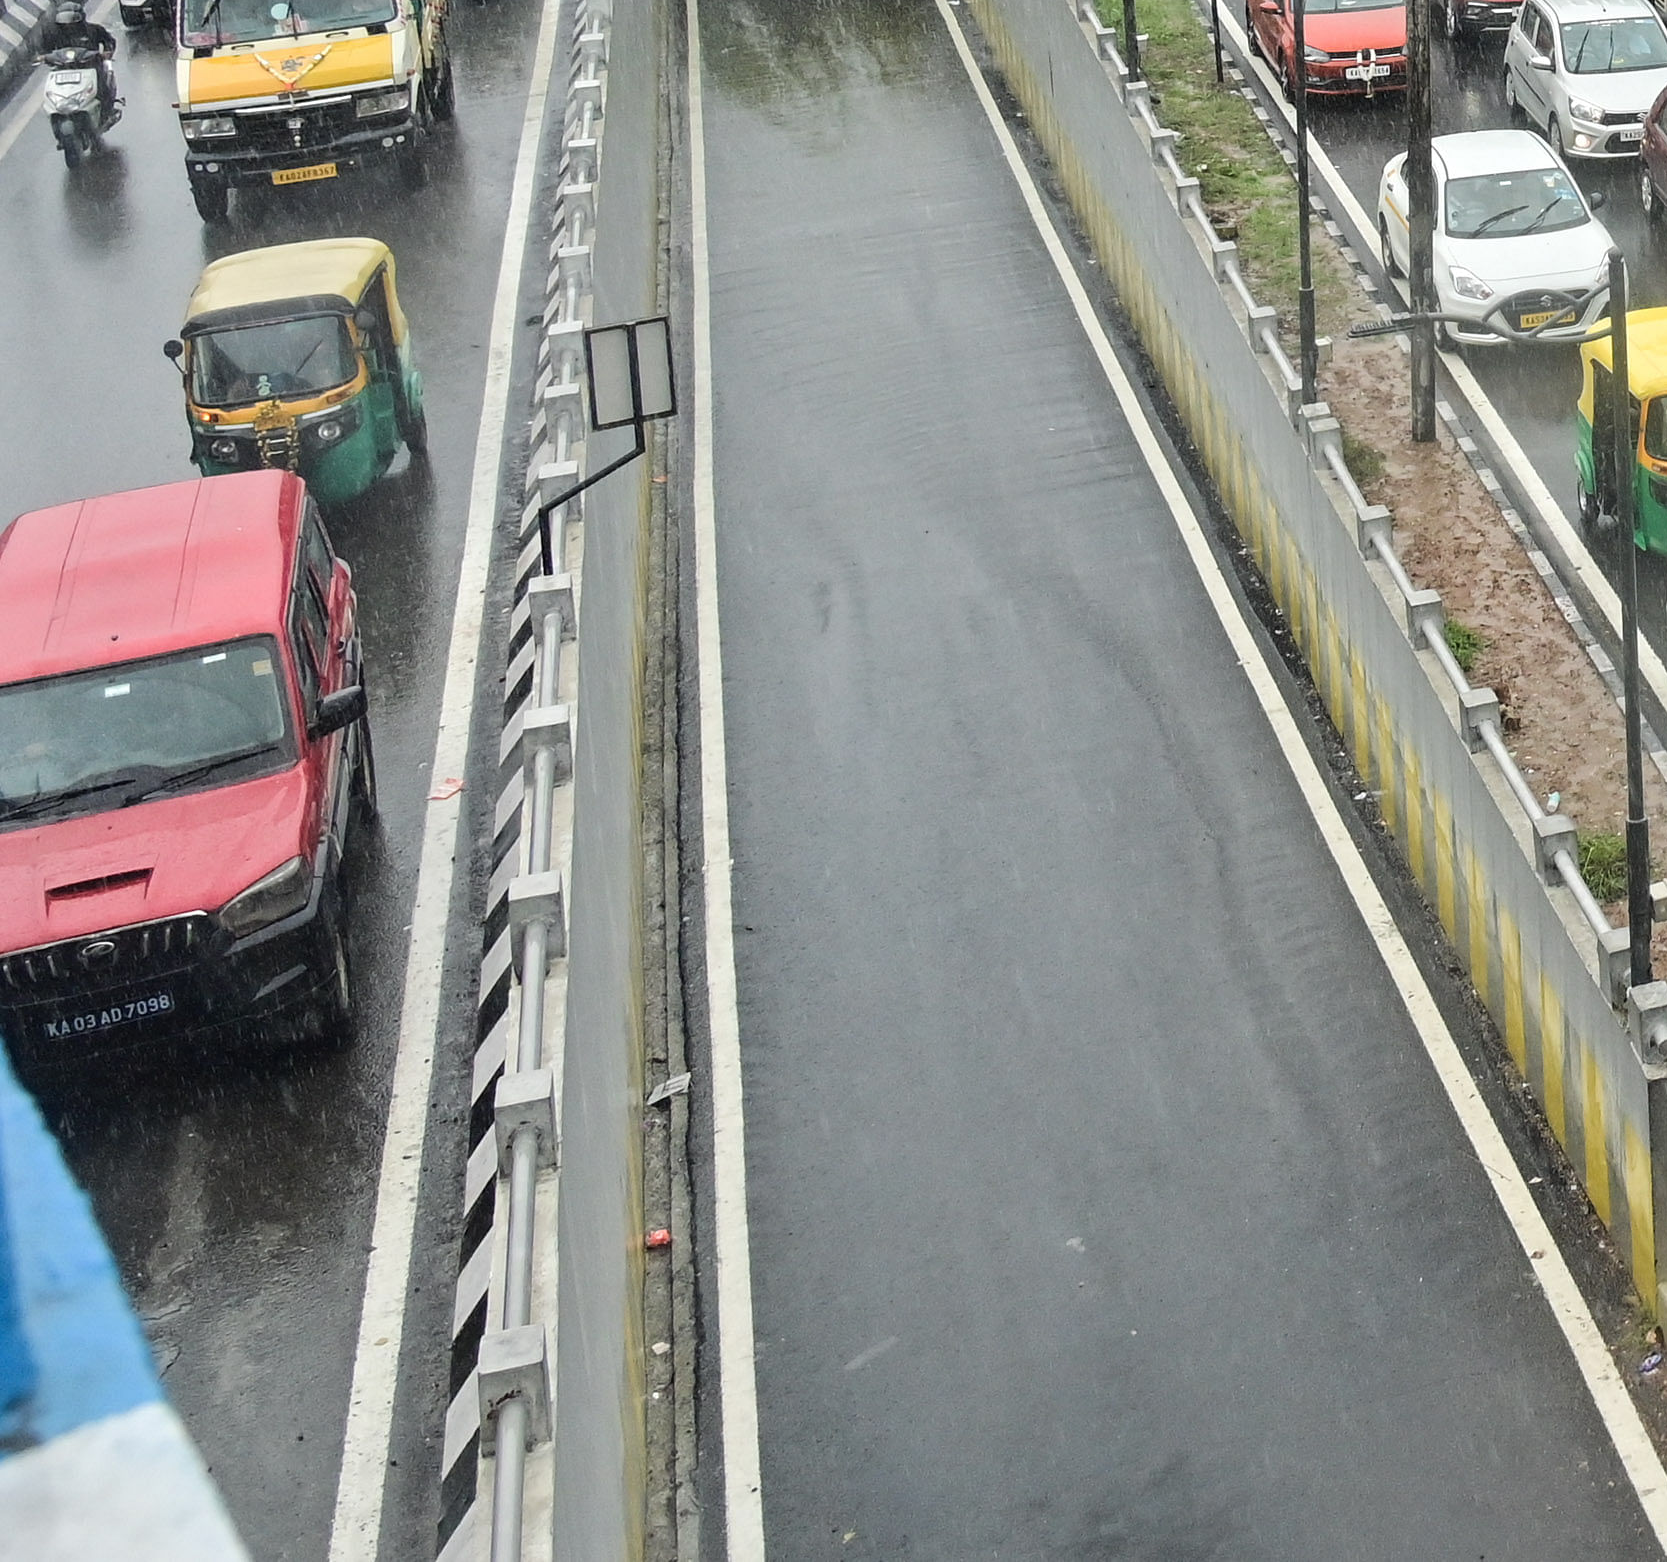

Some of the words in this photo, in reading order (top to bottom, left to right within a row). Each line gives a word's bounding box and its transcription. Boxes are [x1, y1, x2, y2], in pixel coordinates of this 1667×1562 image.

[47, 1018, 70, 1038] KA
[74, 1012, 96, 1031] 03
[101, 1006, 123, 1025] AD
[124, 994, 171, 1018] 7098
